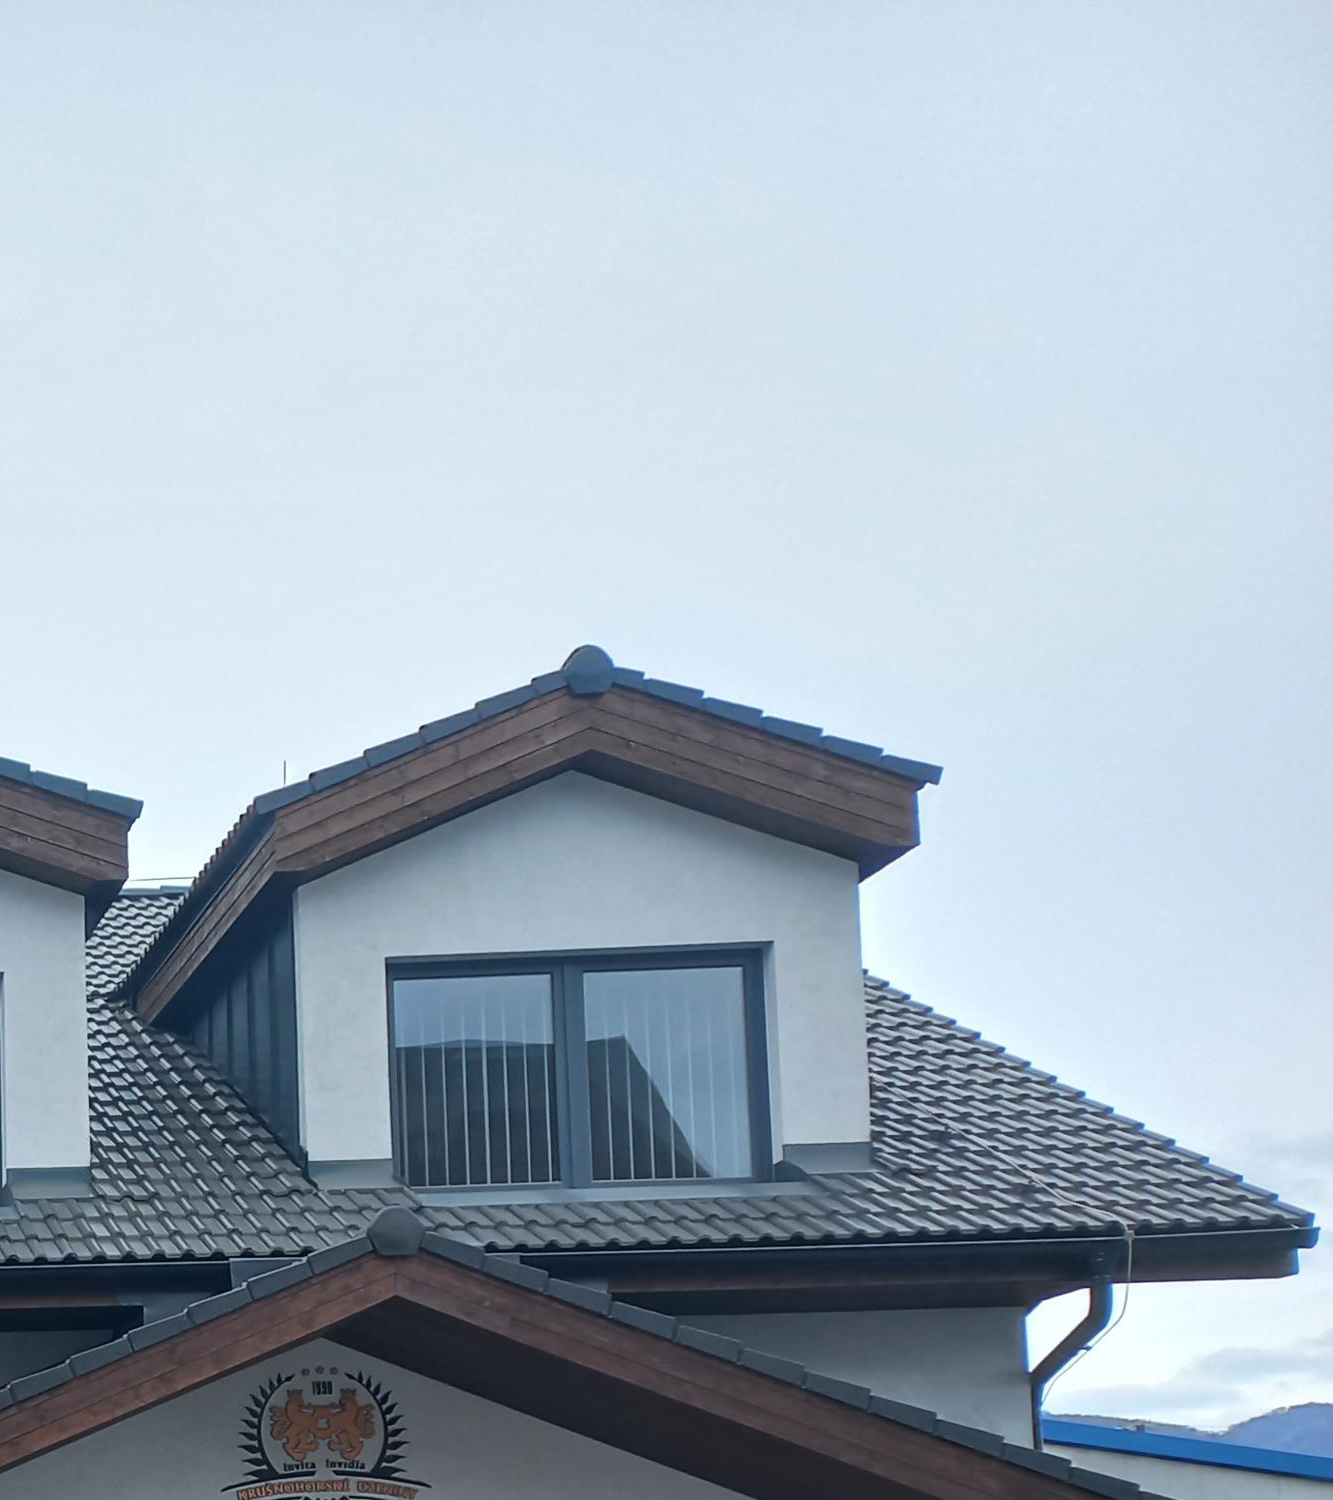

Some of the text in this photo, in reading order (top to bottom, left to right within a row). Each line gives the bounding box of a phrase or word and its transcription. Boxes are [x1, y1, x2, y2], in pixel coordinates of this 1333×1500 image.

[312, 1381, 333, 1396] 1990
[283, 1458, 366, 1472] Invita Invidia
